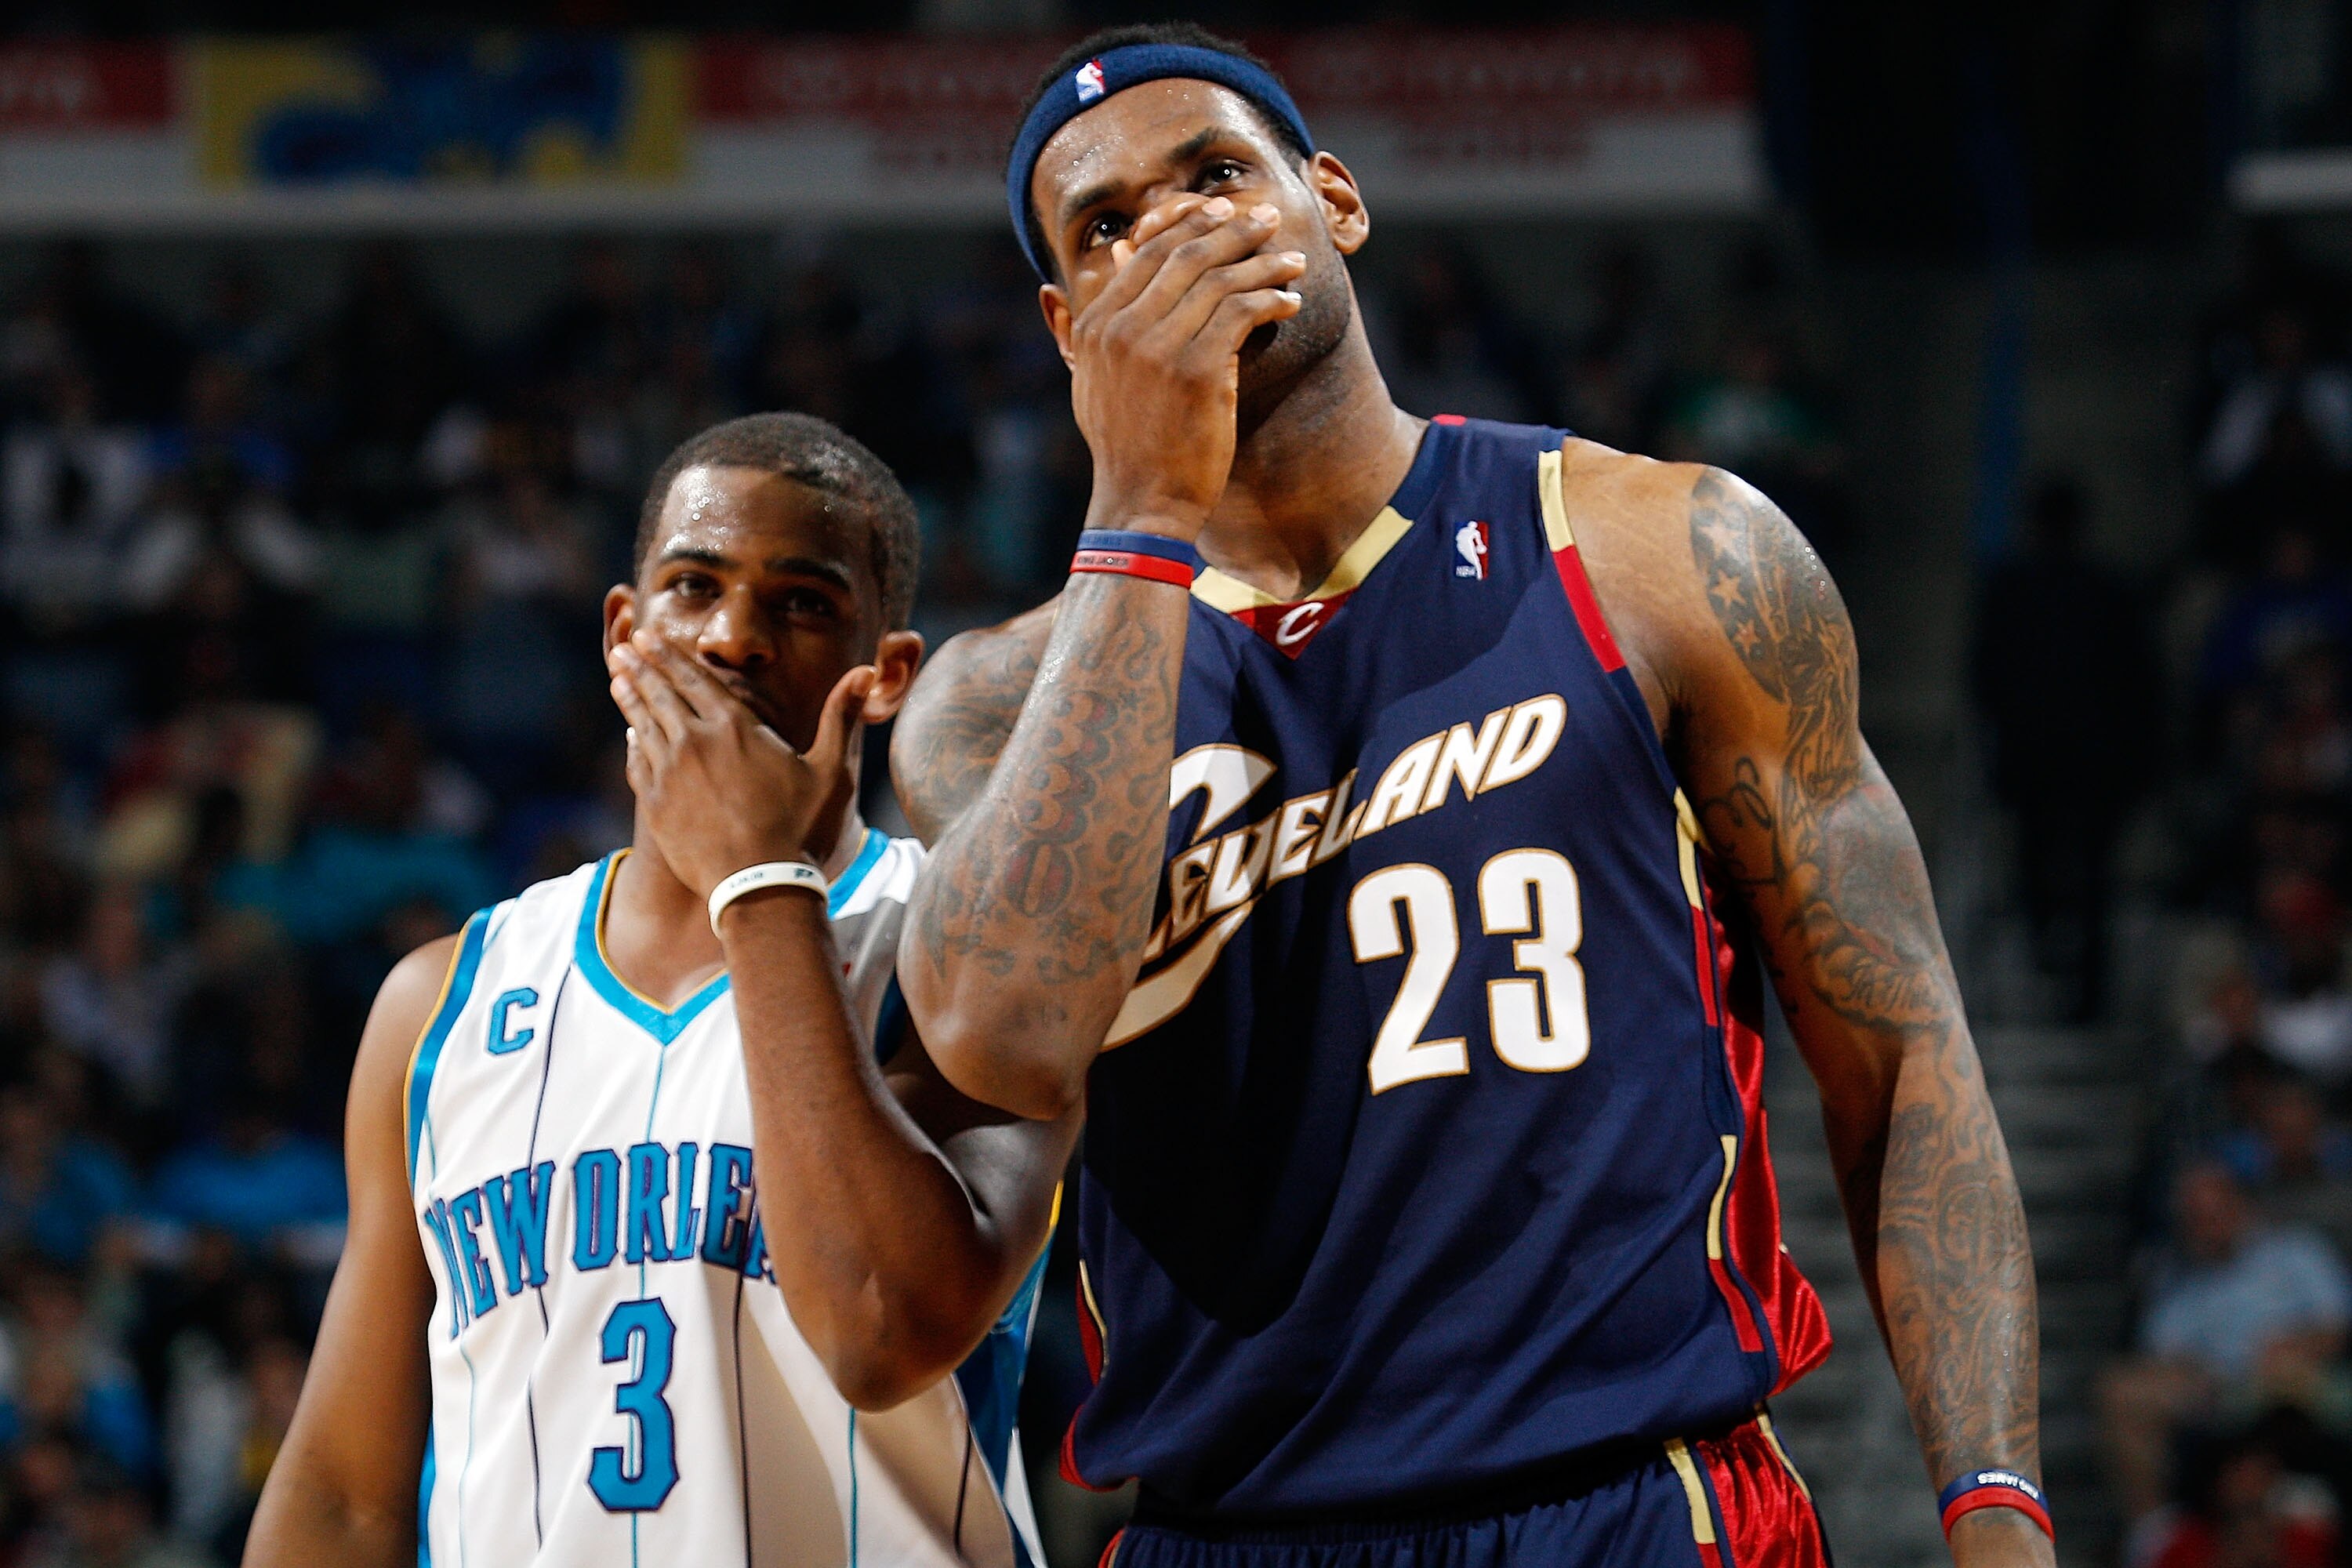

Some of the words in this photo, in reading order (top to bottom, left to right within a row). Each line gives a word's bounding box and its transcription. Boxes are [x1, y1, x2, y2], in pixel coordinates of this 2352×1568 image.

[1276, 601, 1325, 646] C
[1099, 693, 1567, 1053] CEVELAND
[1346, 847, 1592, 1096] 23
[488, 987, 539, 1055] C
[424, 1160, 556, 1342] NEW
[587, 1297, 681, 1513] 3
